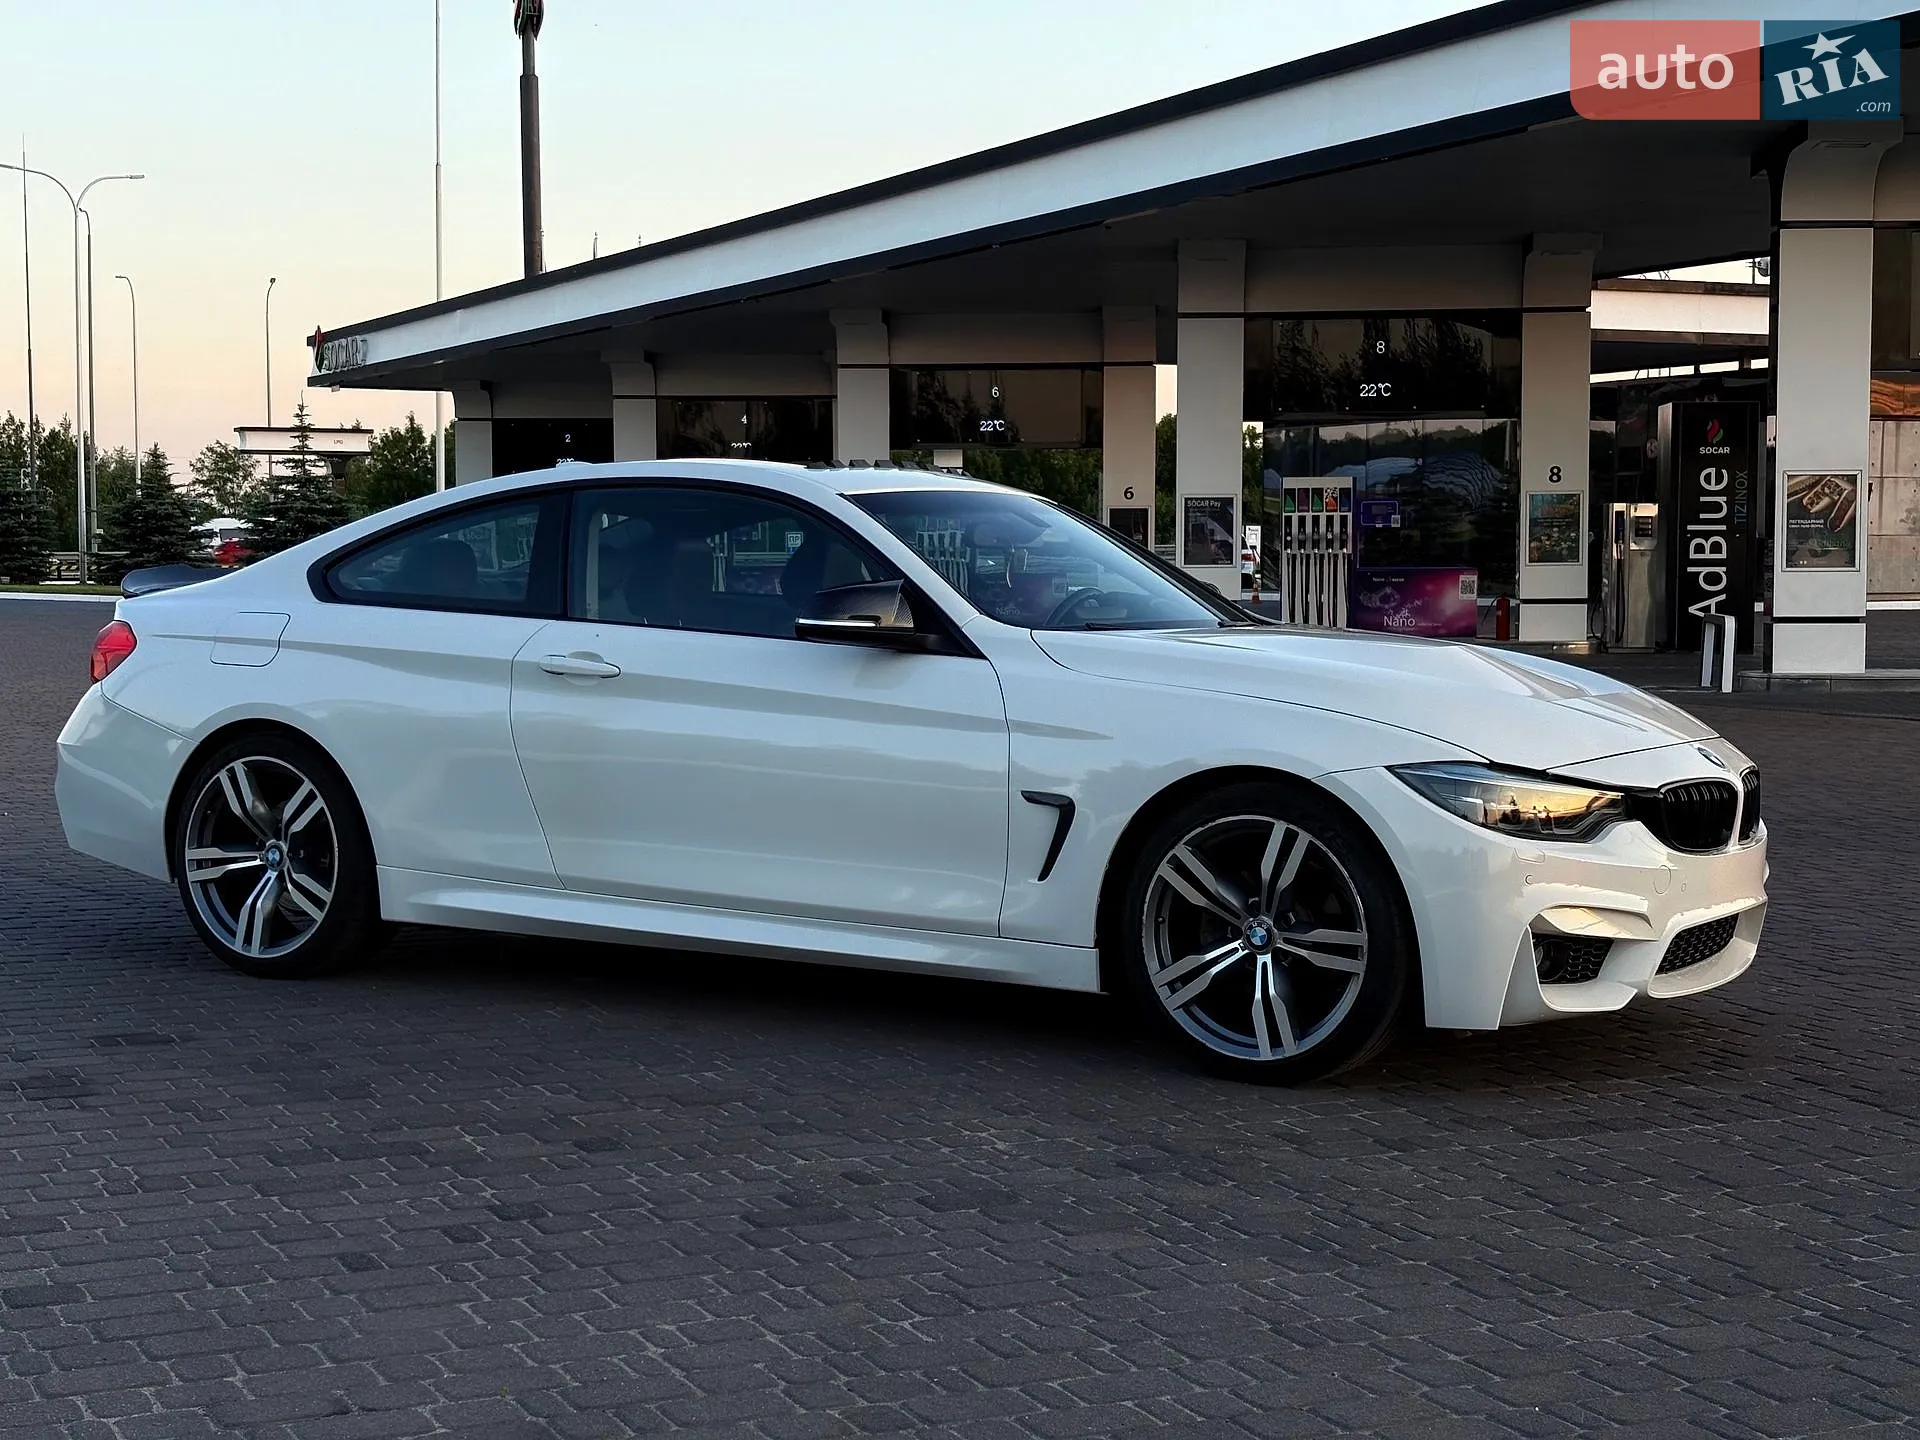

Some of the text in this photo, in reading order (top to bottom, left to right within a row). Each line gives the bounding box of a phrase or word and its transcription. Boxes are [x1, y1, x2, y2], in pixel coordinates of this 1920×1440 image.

[1376, 341, 1385, 354] 8
[992, 386, 1000, 398] 6
[1359, 382, 1392, 397] 22°C
[741, 414, 748, 424] 4
[979, 419, 1005, 432] 22°C
[565, 434, 571, 443] 2
[1548, 466, 1562, 484] 8
[1123, 486, 1134, 501] 6
[1734, 470, 1749, 525] TIZINOX
[1687, 467, 1729, 618] AdBlue
[1384, 615, 1416, 627] Nano
